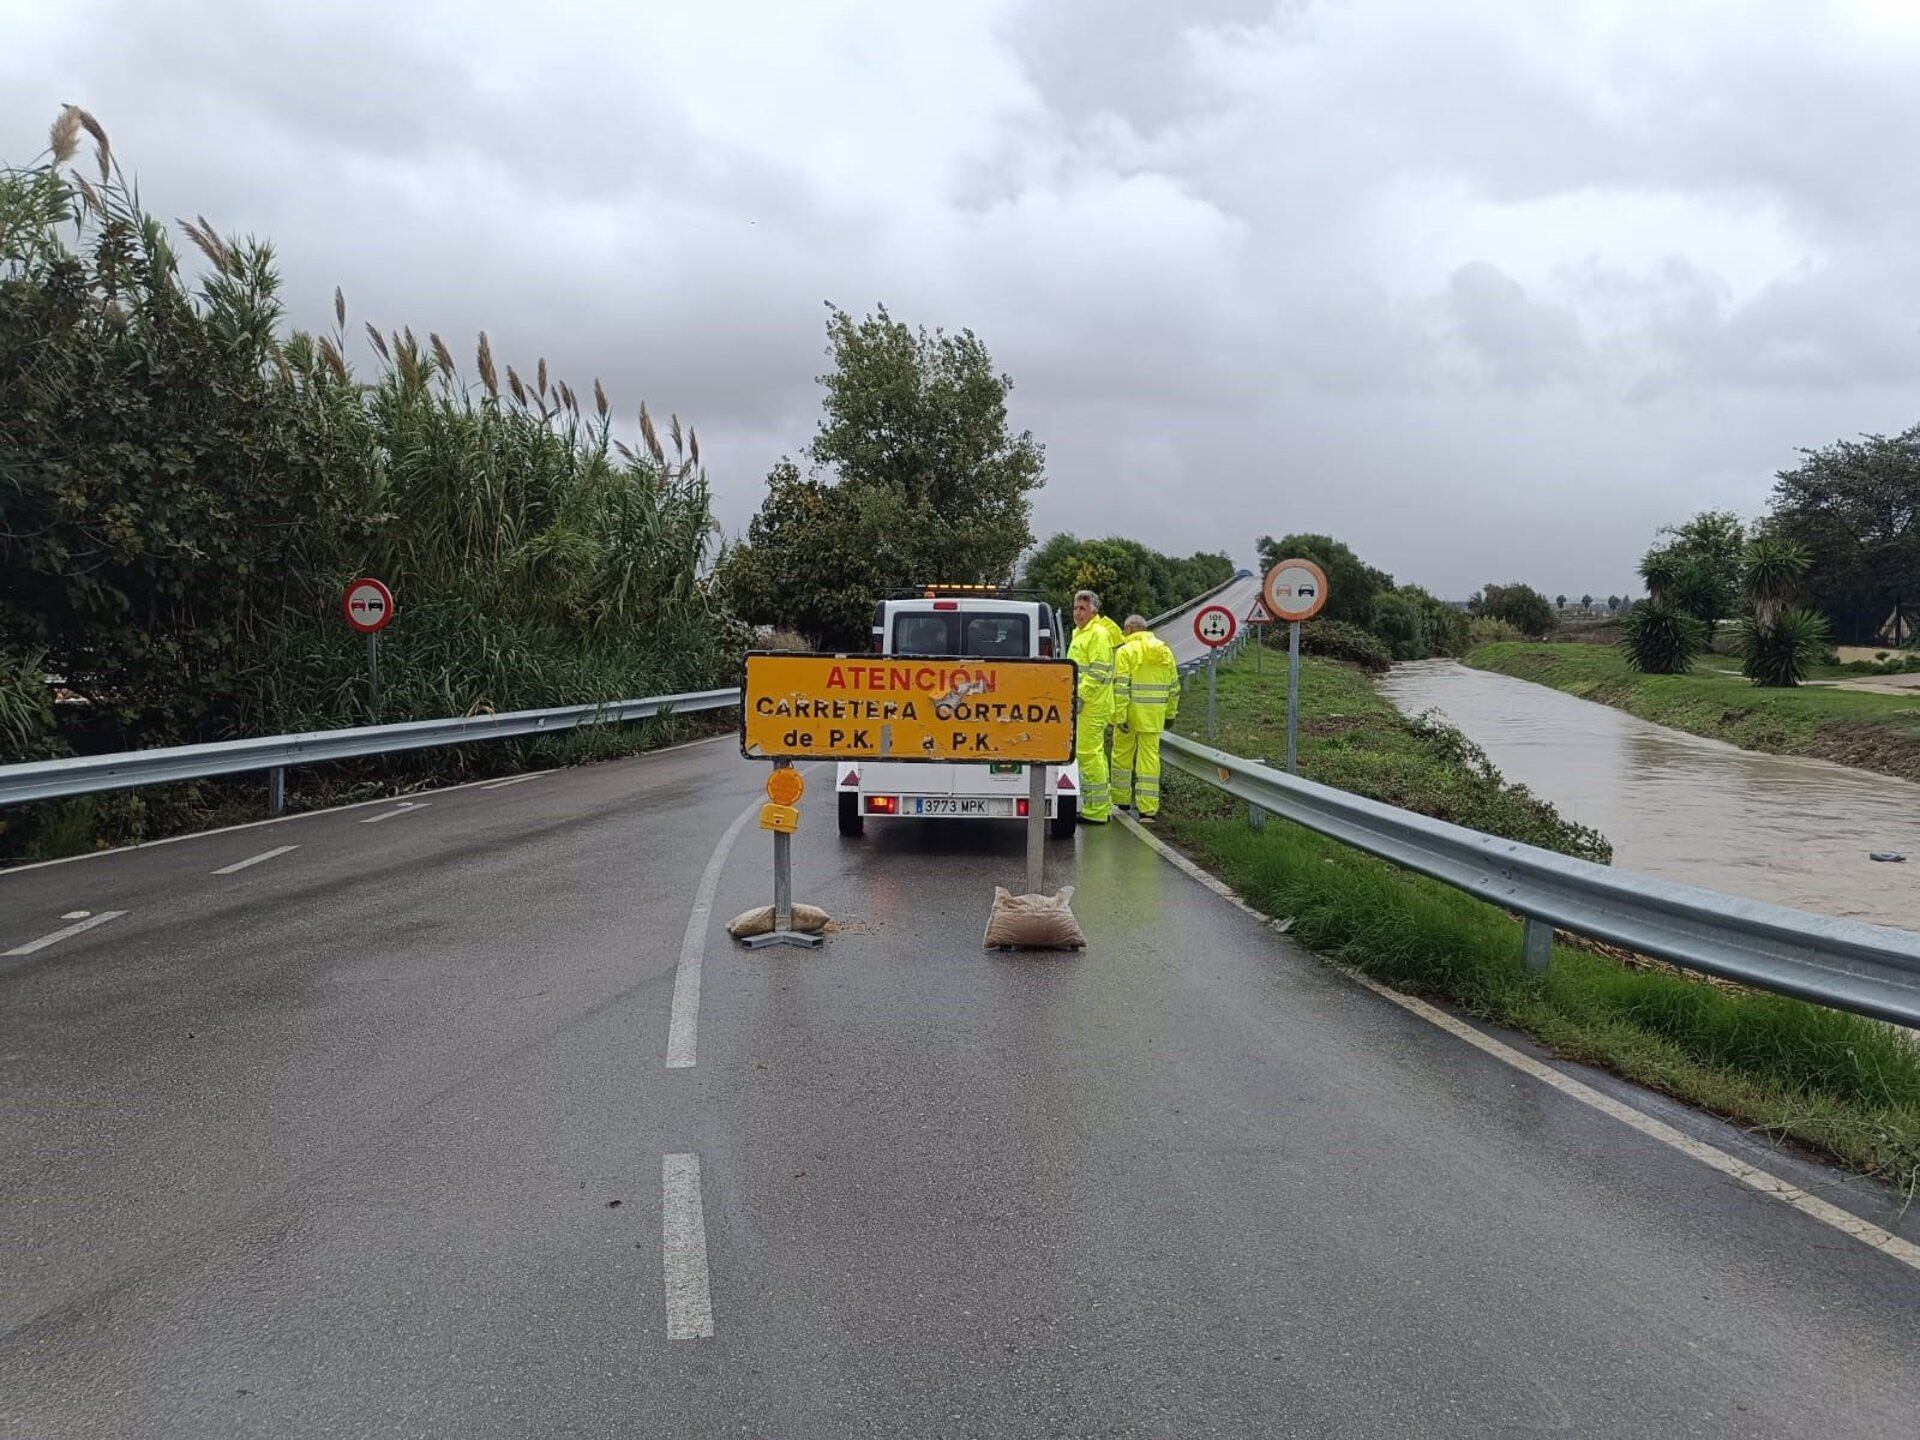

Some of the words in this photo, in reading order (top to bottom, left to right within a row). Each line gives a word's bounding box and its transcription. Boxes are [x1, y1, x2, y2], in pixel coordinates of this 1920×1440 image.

[826, 665, 996, 693] ATENCIÓN
[756, 696, 917, 721] CARRETERA
[935, 702, 1061, 724] CORTADA
[783, 729, 813, 747] de
[829, 729, 873, 749] P.K.
[952, 732, 998, 751] P.K.
[925, 800, 957, 812] 3773
[961, 801, 985, 812] MPK
